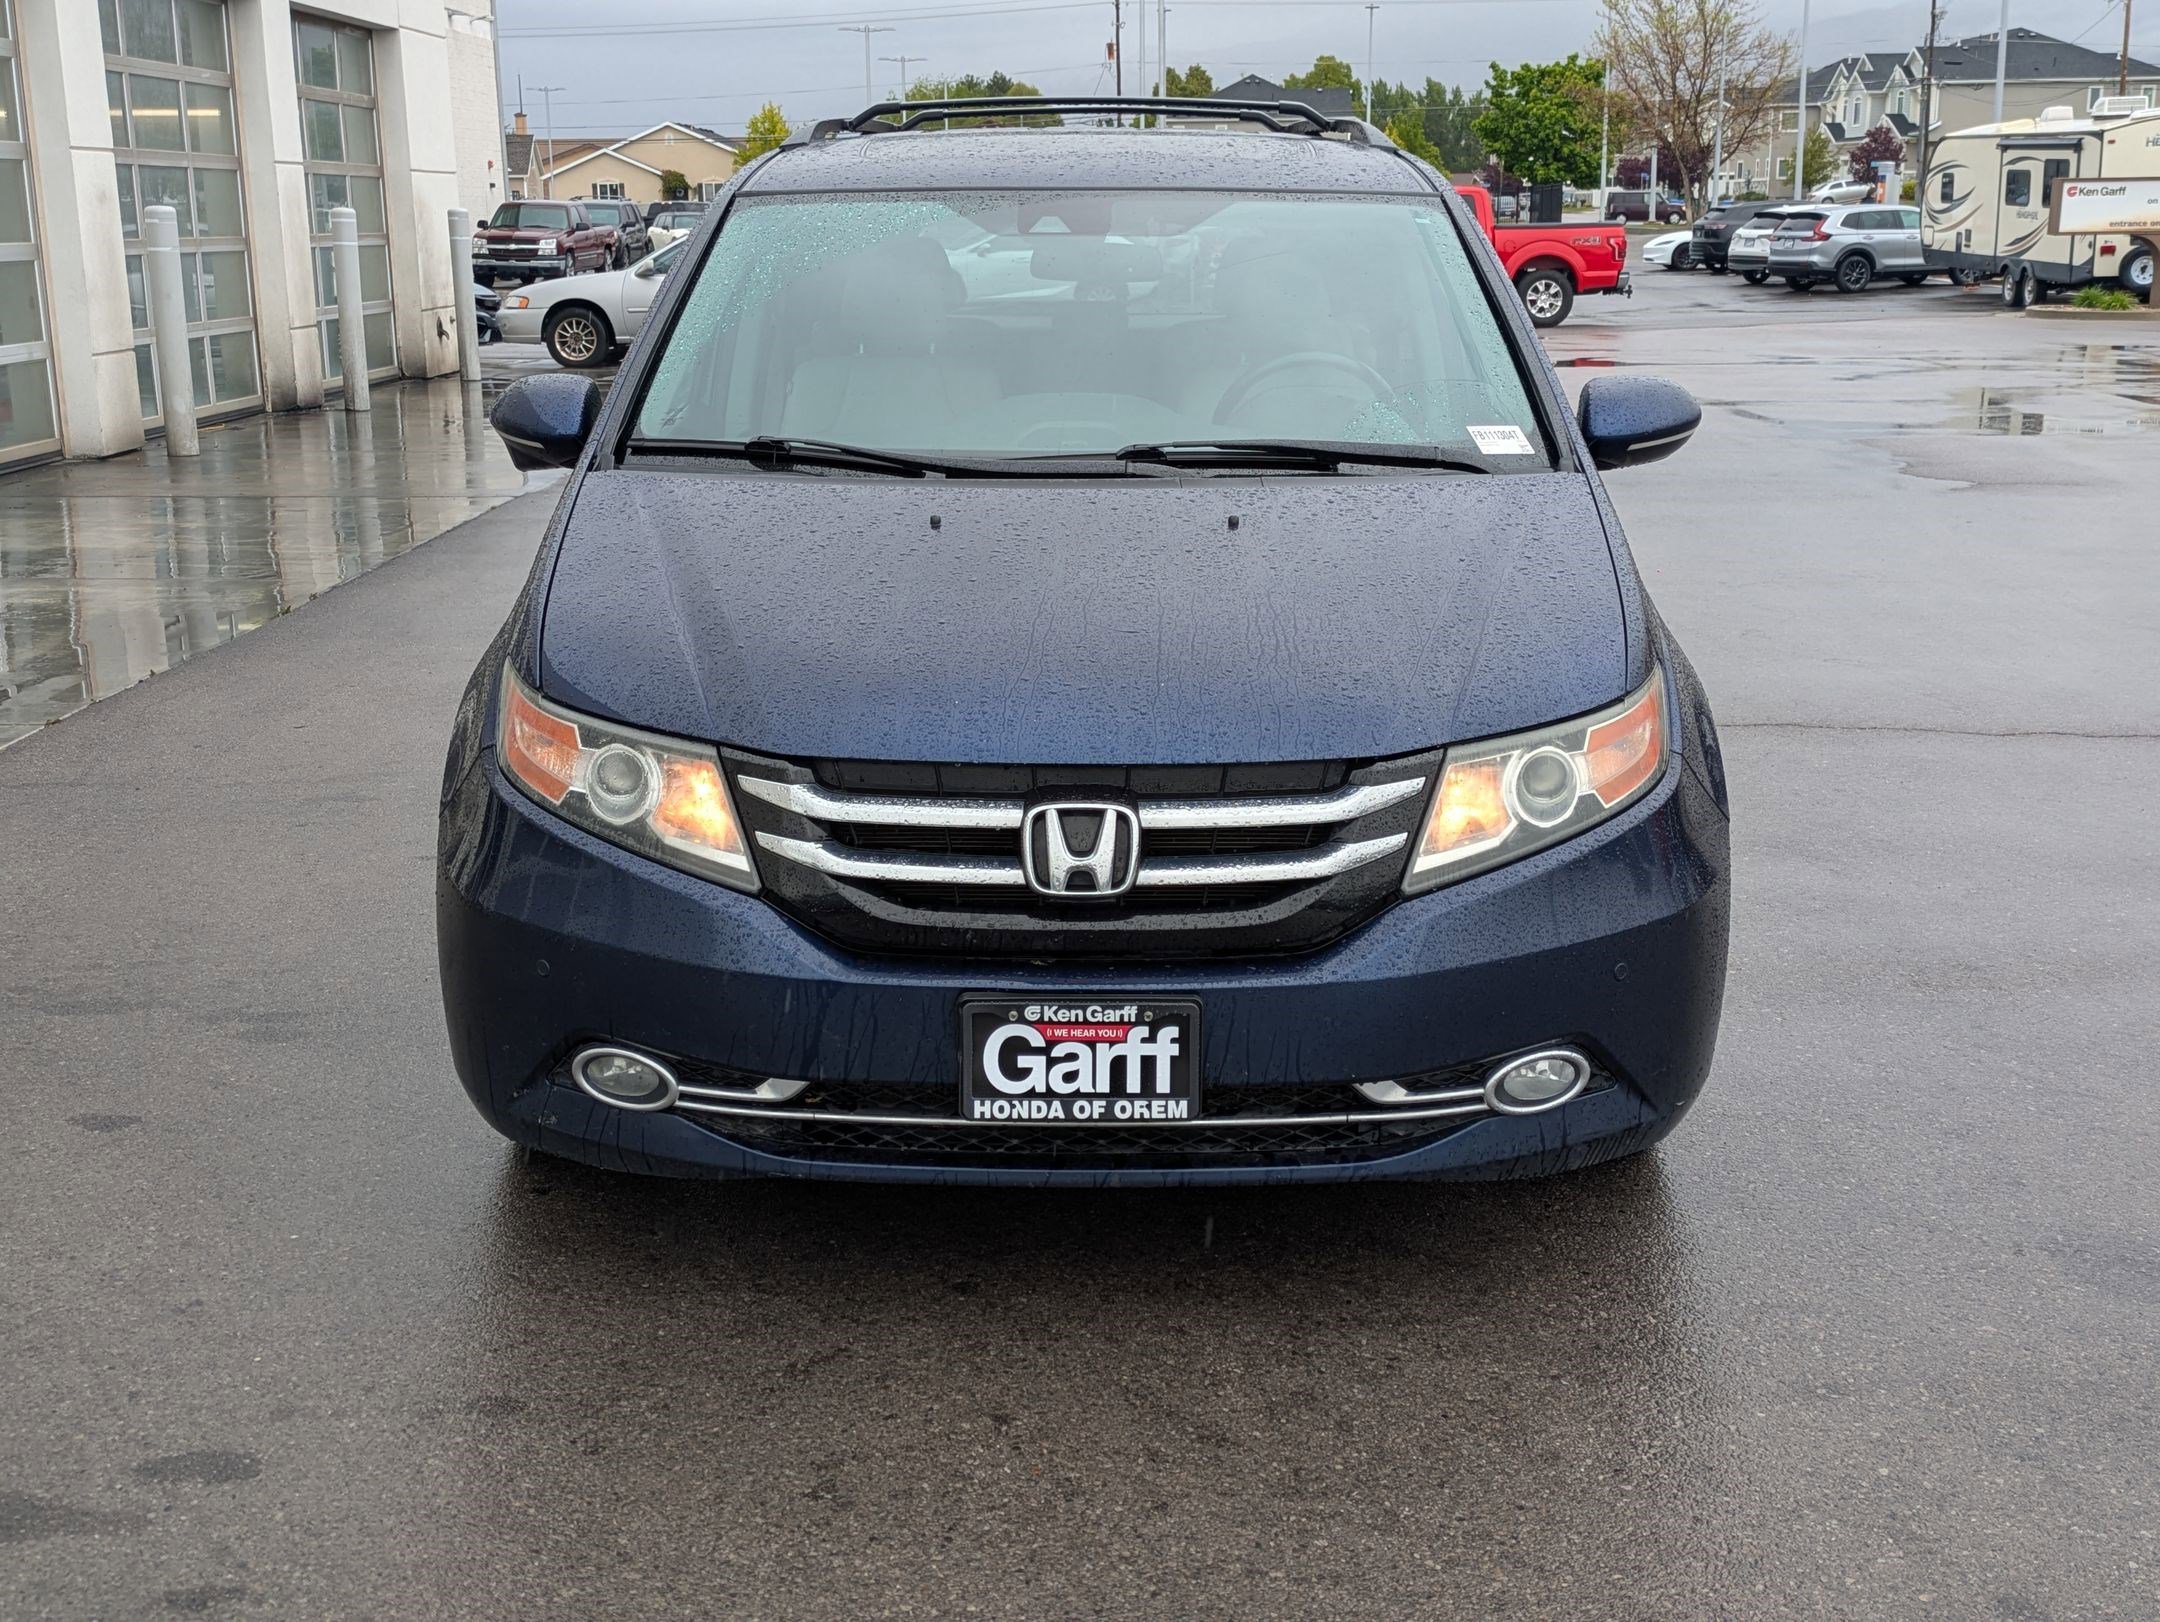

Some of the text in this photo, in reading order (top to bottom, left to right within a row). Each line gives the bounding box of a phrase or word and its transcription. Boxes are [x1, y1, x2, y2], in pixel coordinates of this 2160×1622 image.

[2079, 186, 2126, 196] Ken Garff
[1043, 1006, 1138, 1022] Ken Garff
[1054, 1029, 1117, 1037] WE HEAR YOU
[982, 1023, 1180, 1095] Garff
[973, 1100, 1189, 1120] HONDA OF OREM
